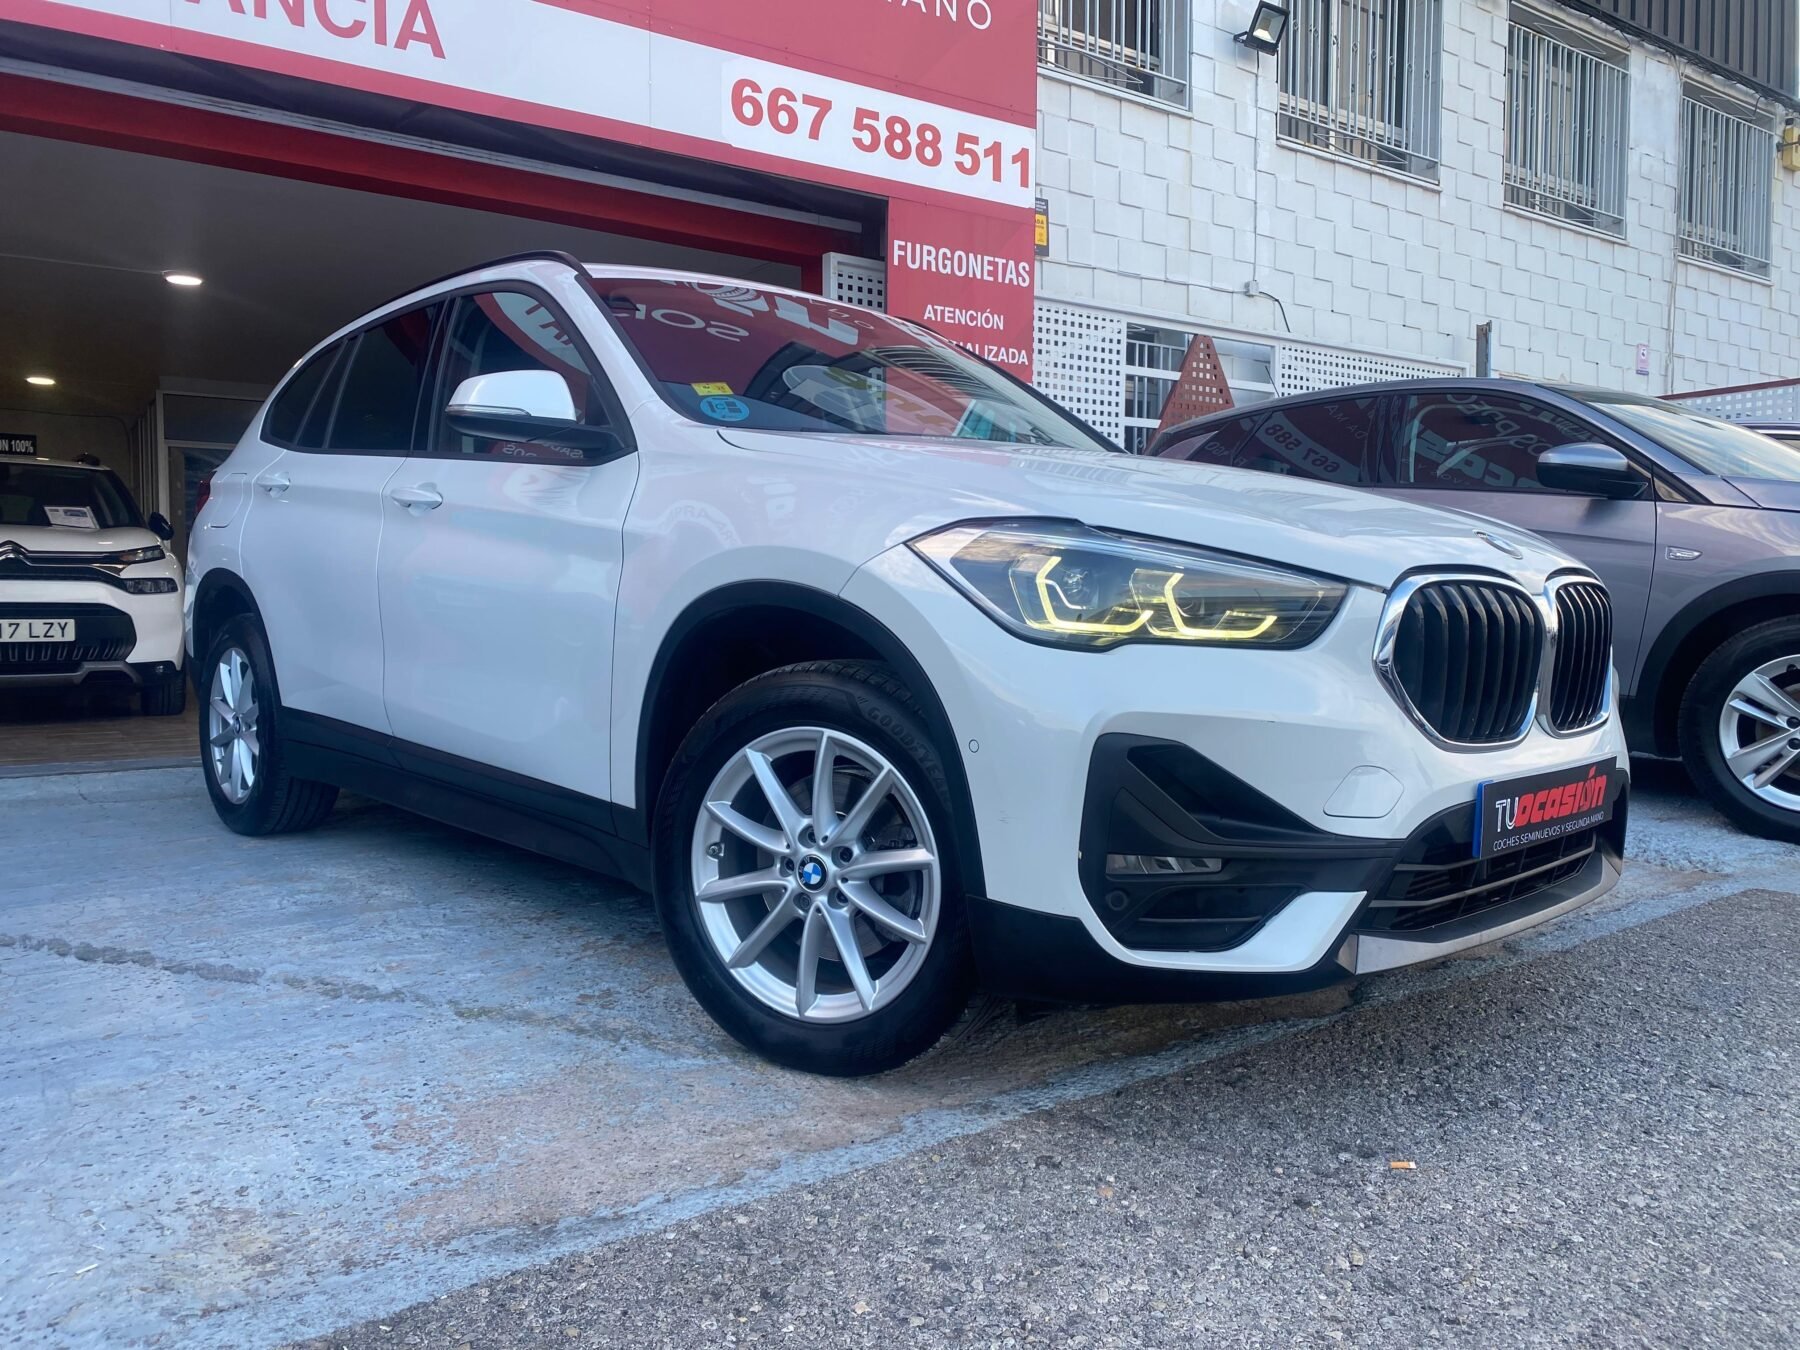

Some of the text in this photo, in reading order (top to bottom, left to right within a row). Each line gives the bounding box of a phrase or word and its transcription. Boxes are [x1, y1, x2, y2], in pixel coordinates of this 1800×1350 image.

[887, 0, 992, 30] NO
[184, 0, 446, 59] CIA
[731, 79, 1029, 188] 667 588 511
[893, 239, 1030, 288] FURGONETAS
[923, 304, 1004, 331] ATENCIÓN
[950, 340, 1029, 365] LIZADA
[11, 440, 34, 453] 100%
[29, 622, 68, 638] LZY
[1493, 836, 1519, 852] COCHES
[1520, 826, 1561, 844] SEMINUEVOS
